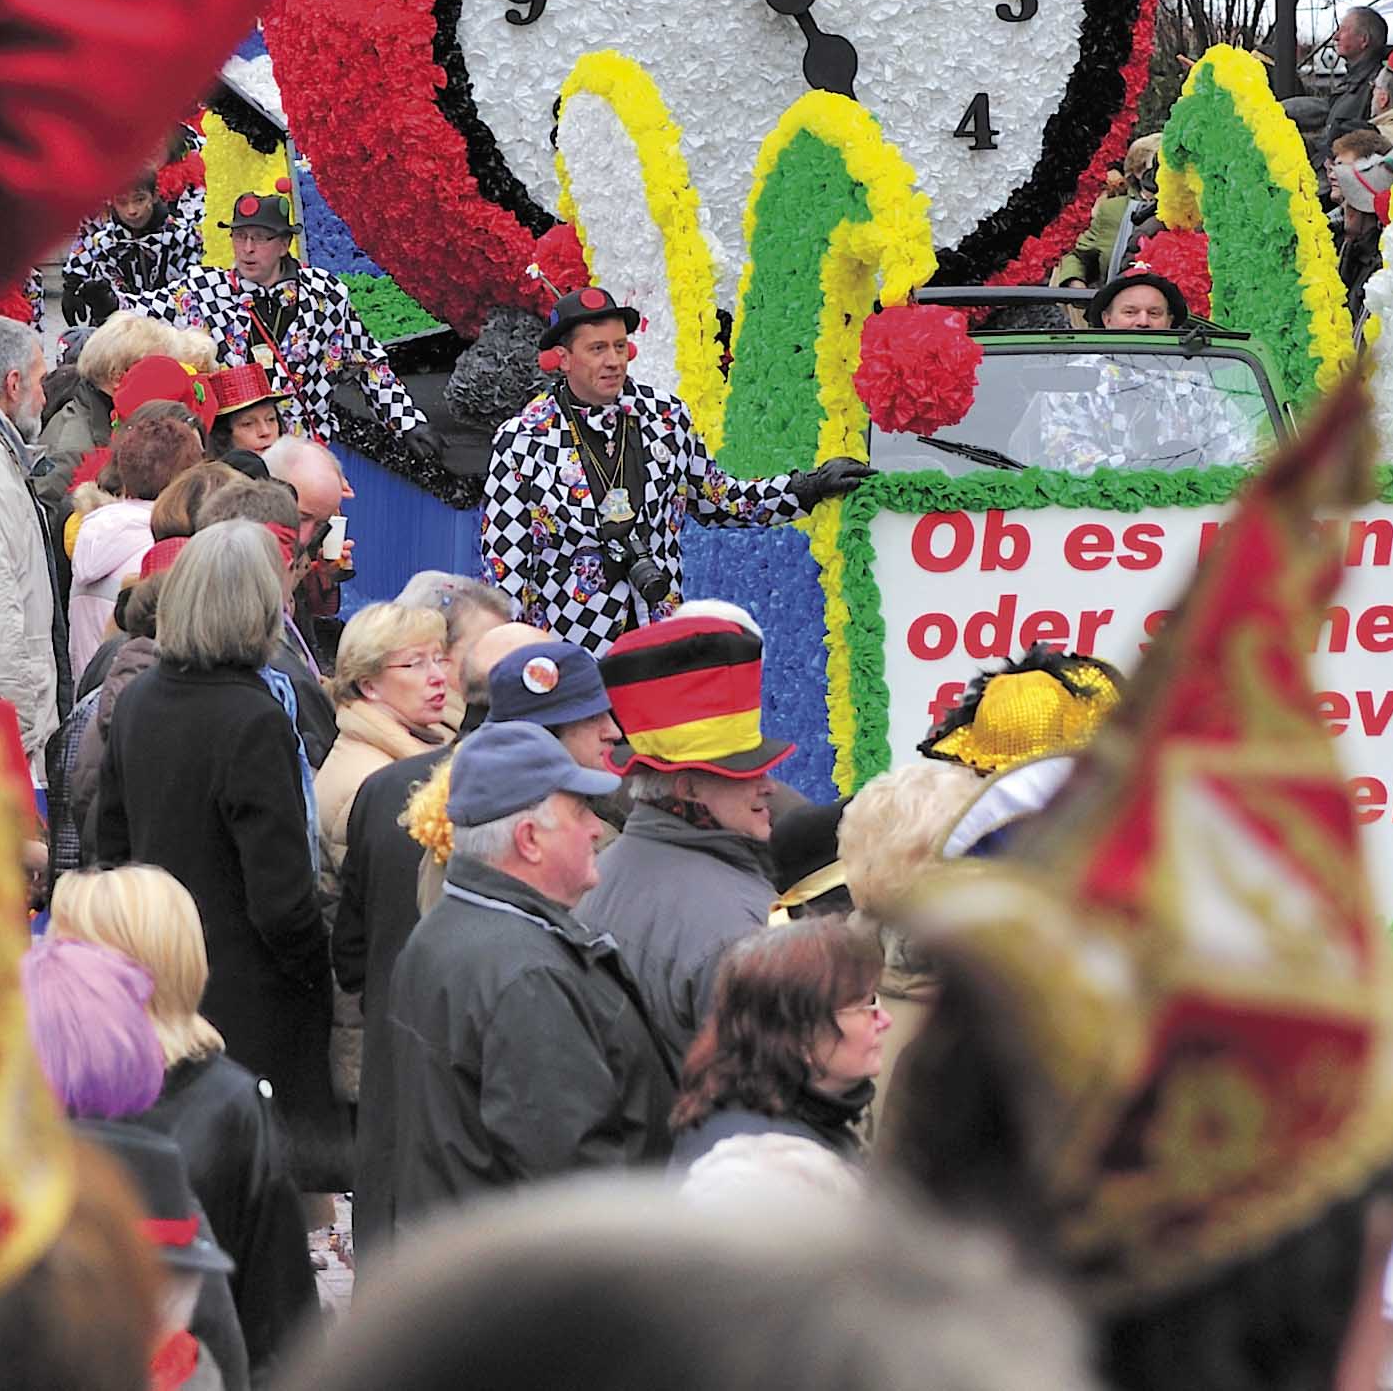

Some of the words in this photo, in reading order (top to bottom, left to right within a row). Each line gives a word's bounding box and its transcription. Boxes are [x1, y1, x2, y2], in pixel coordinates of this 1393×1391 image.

[954, 92, 999, 151] 4
[910, 509, 1031, 573] Ob
[1063, 521, 1164, 572] es
[906, 594, 1114, 661] oder
